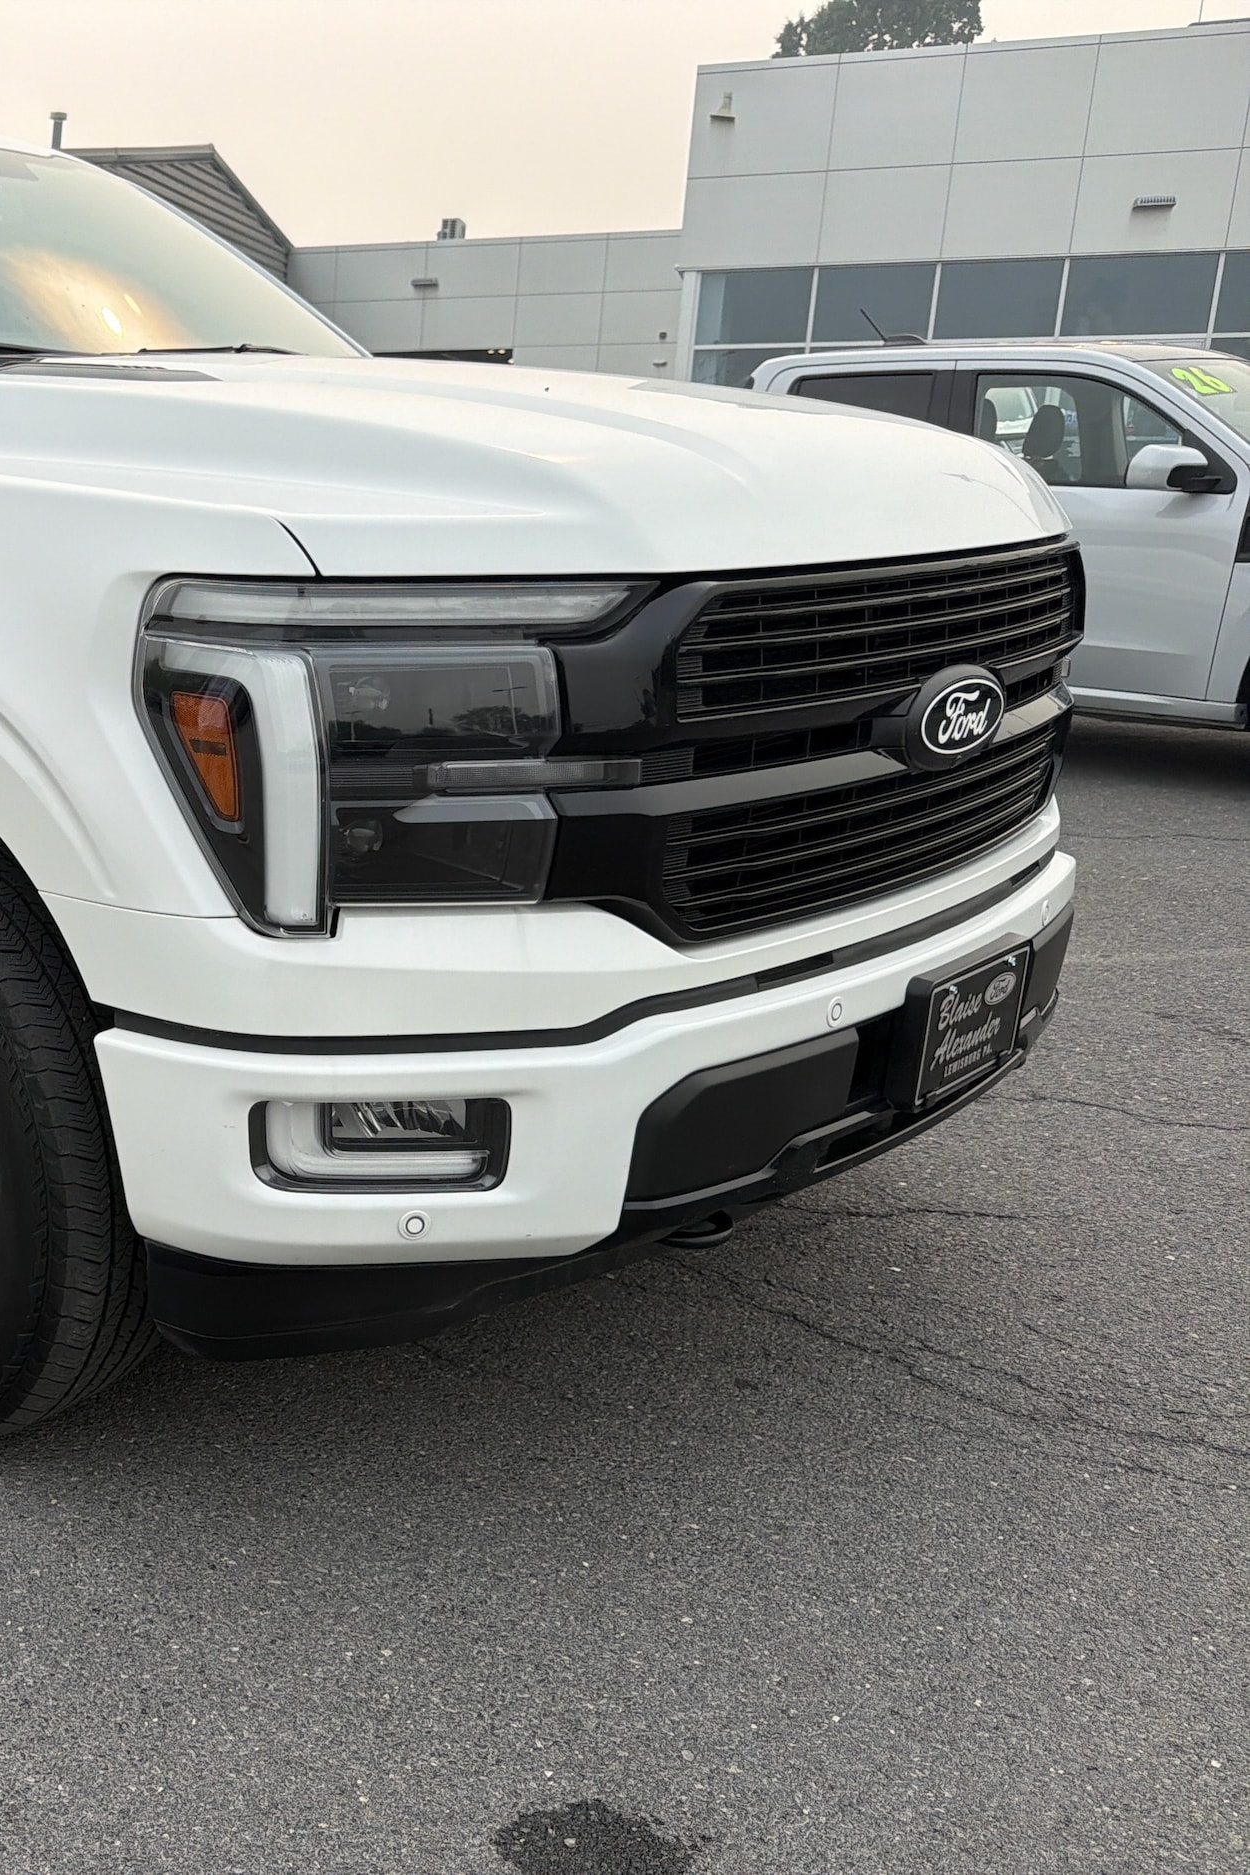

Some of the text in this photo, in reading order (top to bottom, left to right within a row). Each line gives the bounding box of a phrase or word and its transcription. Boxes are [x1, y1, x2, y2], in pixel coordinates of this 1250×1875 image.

[1171, 366, 1234, 395] 26
[938, 690, 991, 744] Ford
[938, 993, 983, 1031] Blaise
[930, 1011, 1001, 1071] Alexander
[944, 1048, 981, 1078] LEWISBURG
